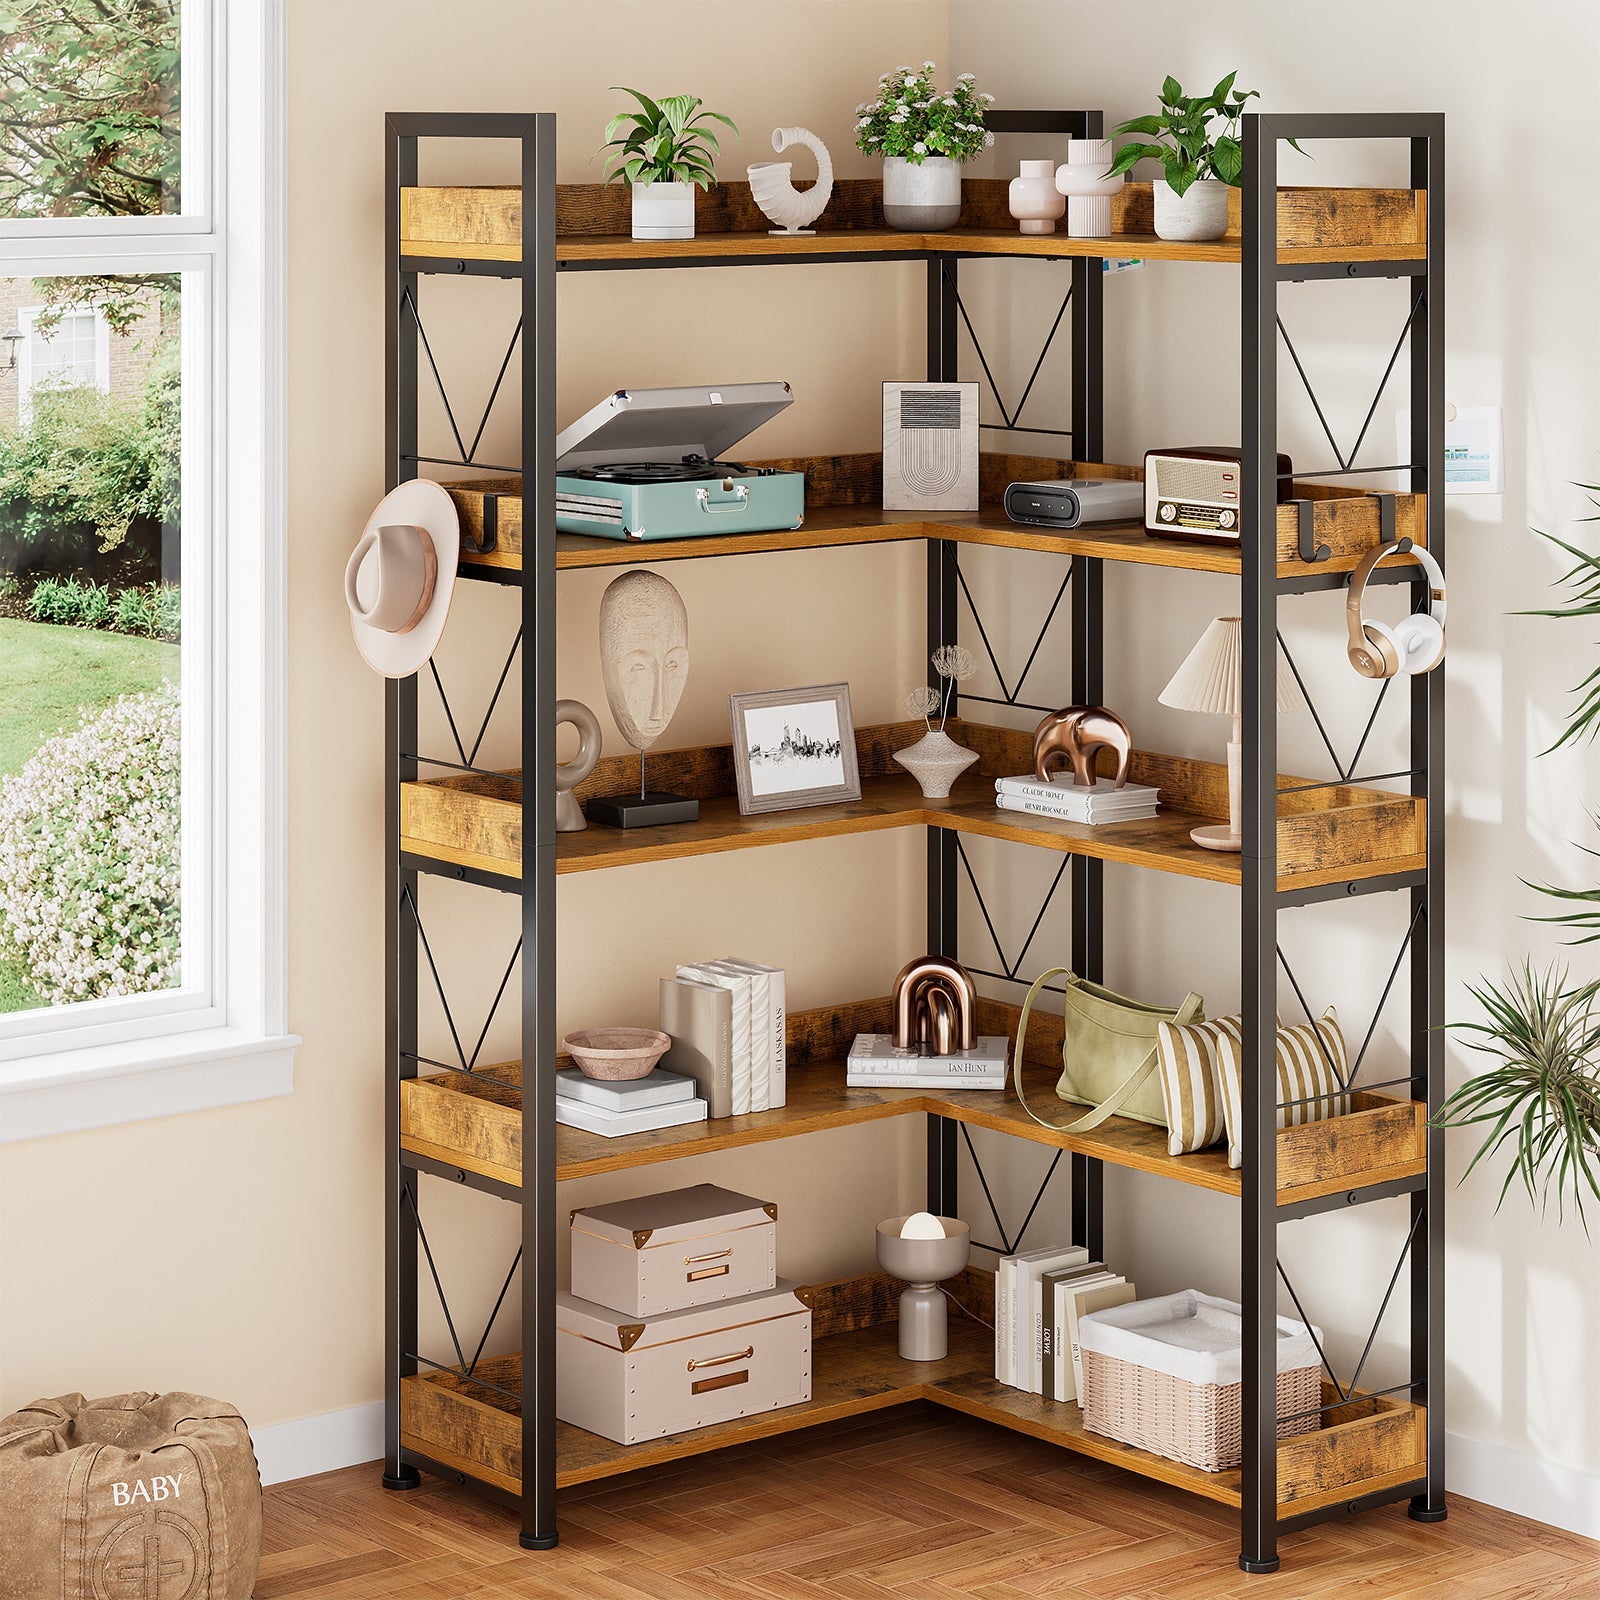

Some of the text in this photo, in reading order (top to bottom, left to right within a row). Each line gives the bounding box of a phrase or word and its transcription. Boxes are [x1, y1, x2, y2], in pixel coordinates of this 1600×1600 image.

[1024, 802, 1041, 812] HENRI
[775, 1007, 783, 1062] LASKASAS
[1043, 1327, 1051, 1356] LOEWE
[110, 1473, 183, 1507] BABY
